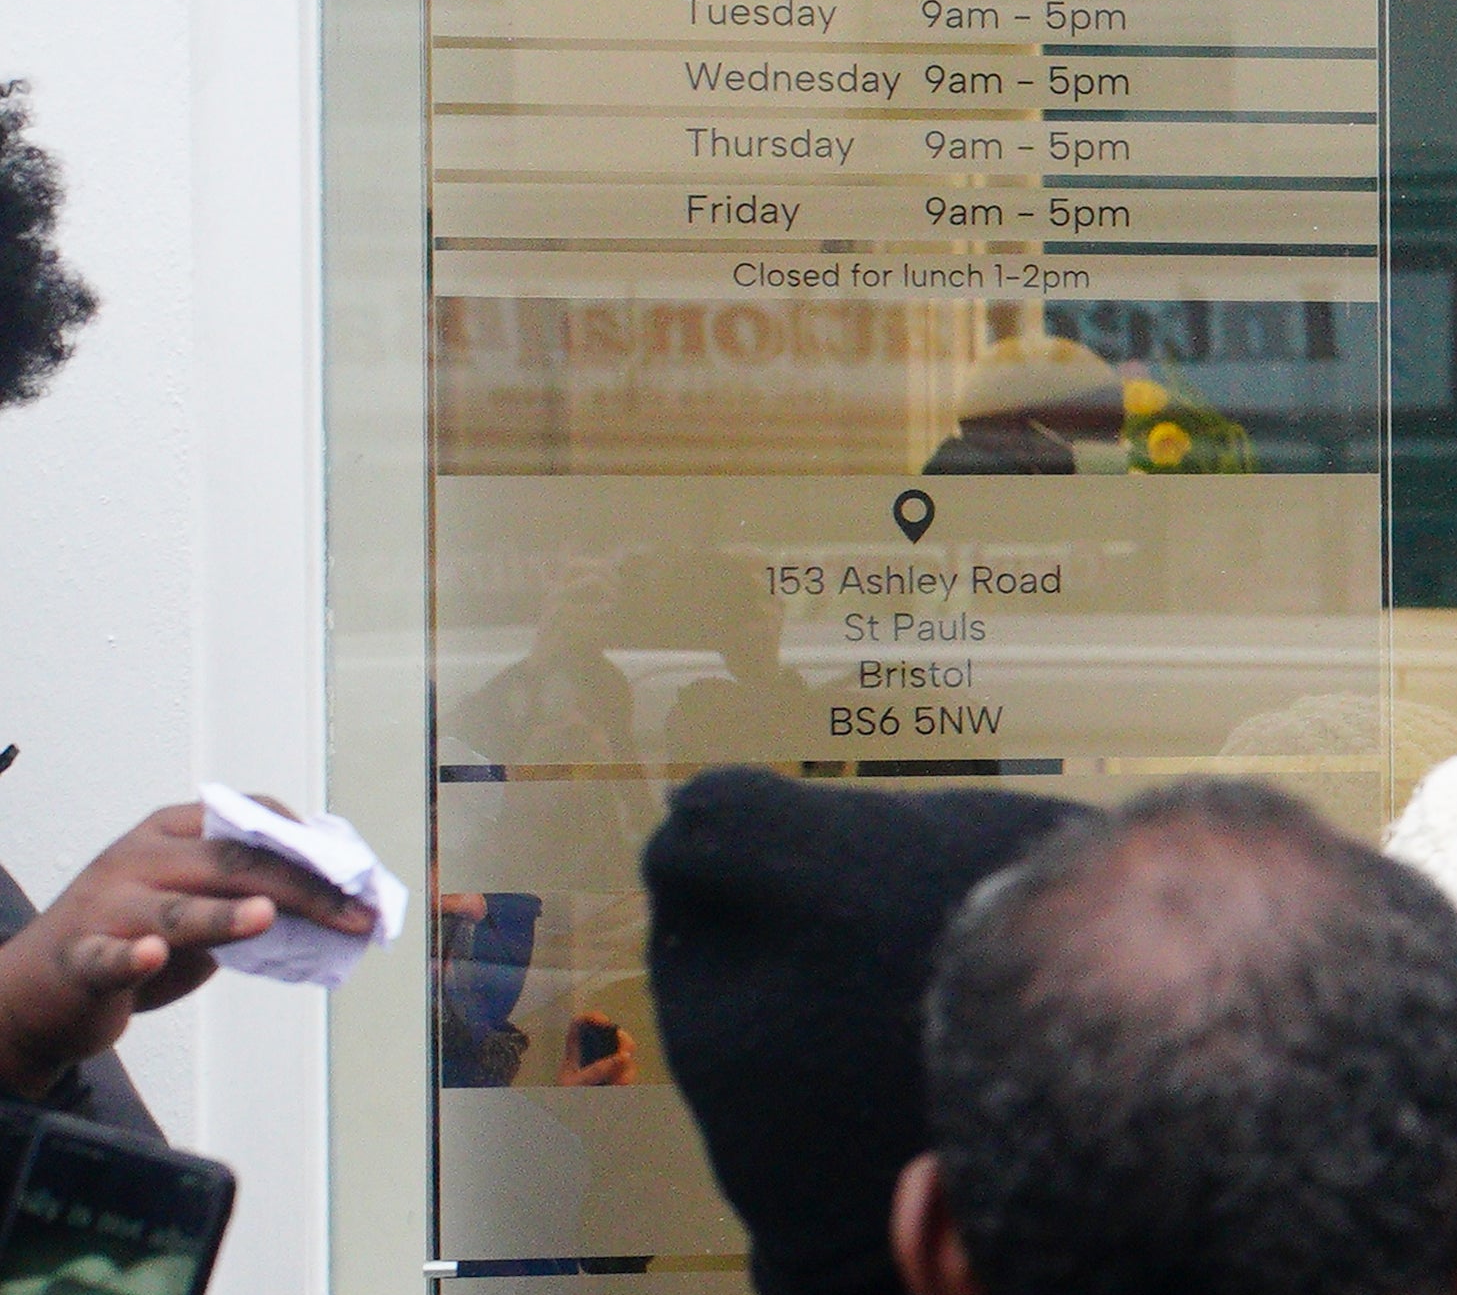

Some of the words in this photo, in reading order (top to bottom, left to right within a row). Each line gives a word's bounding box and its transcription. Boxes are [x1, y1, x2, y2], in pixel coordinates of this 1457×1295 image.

[921, 0, 999, 30] 9am
[1045, 0, 1126, 38] 5pm
[684, 61, 902, 102] Wednesday
[924, 64, 1003, 94] 9am
[1049, 65, 1130, 103] 5pm
[685, 127, 855, 167] Thursday
[924, 130, 1003, 160] 9am
[1049, 131, 1130, 168] 5pm
[687, 194, 801, 232] Friday
[925, 196, 1003, 226] 9am
[1049, 197, 1130, 235] 5pm
[732, 261, 840, 288] Closed
[850, 262, 894, 288] for
[903, 262, 984, 288] lunch
[765, 565, 825, 596] 153
[838, 564, 959, 602] Ashley
[972, 564, 1062, 595] Road
[844, 612, 880, 642] St
[892, 611, 986, 642] Pauls
[857, 659, 972, 690] Bristol
[830, 706, 901, 737] BS6
[914, 706, 1003, 736] 5NW
